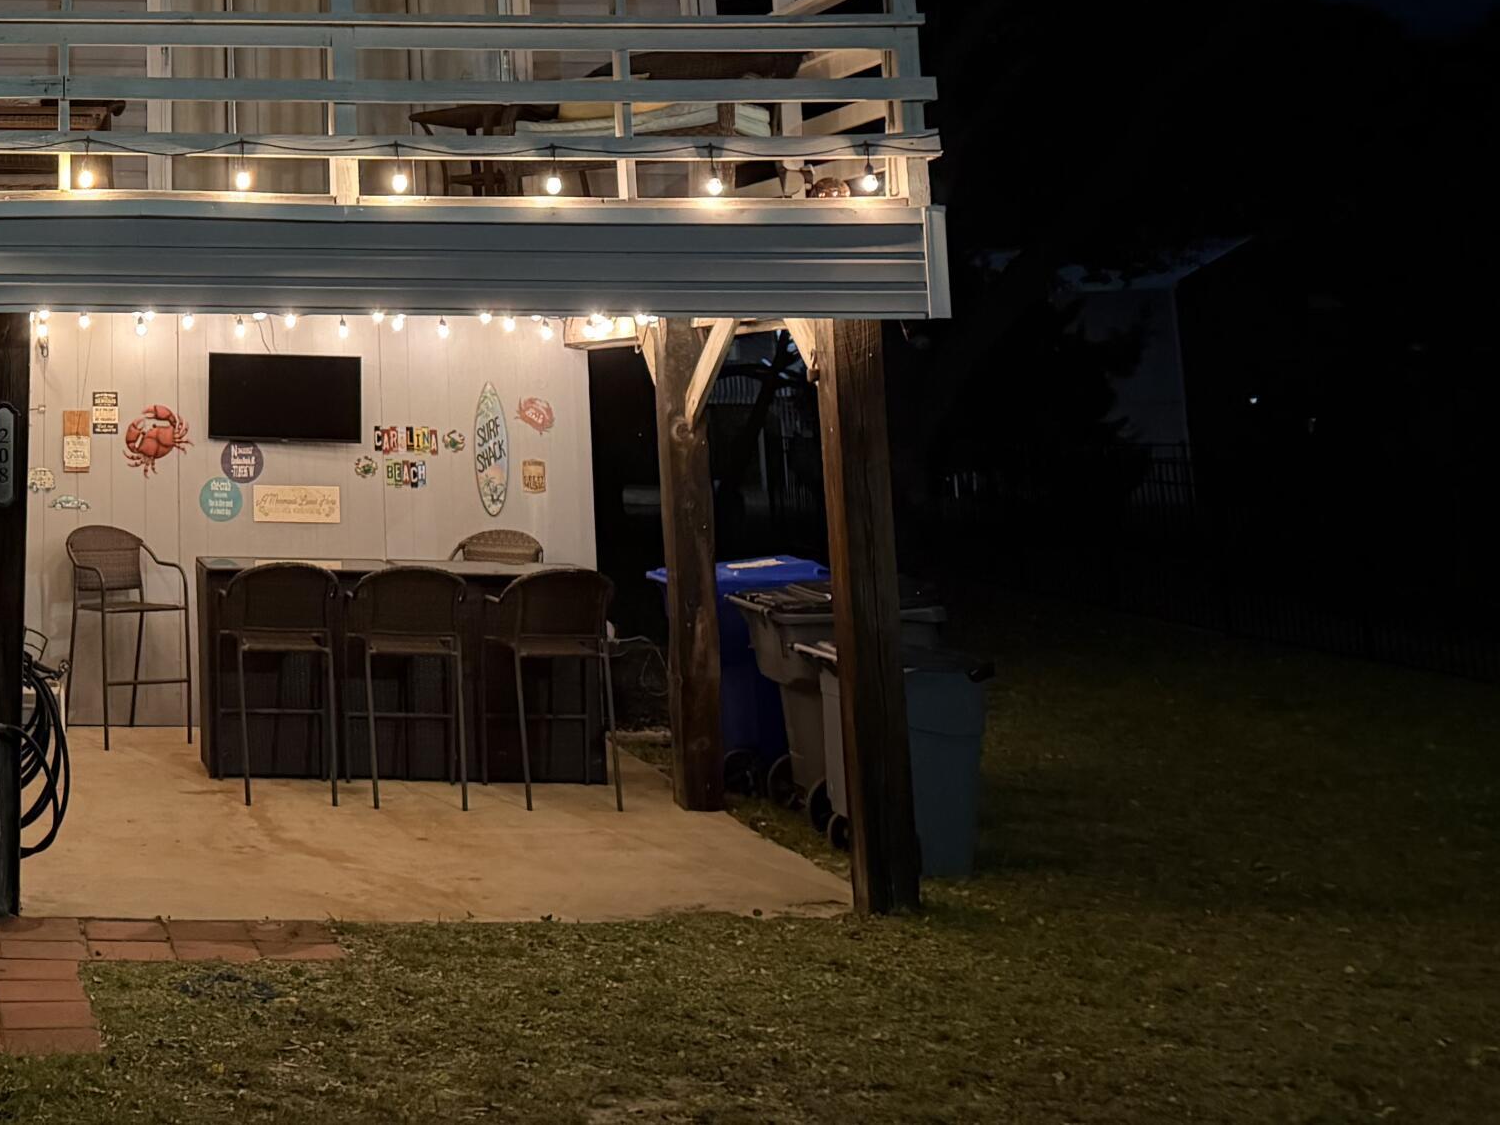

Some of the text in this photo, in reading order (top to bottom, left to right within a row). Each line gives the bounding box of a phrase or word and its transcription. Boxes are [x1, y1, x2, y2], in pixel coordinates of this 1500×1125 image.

[477, 416, 501, 447] SURF
[476, 439, 506, 473] SHACK
[386, 461, 426, 487] BEACH
